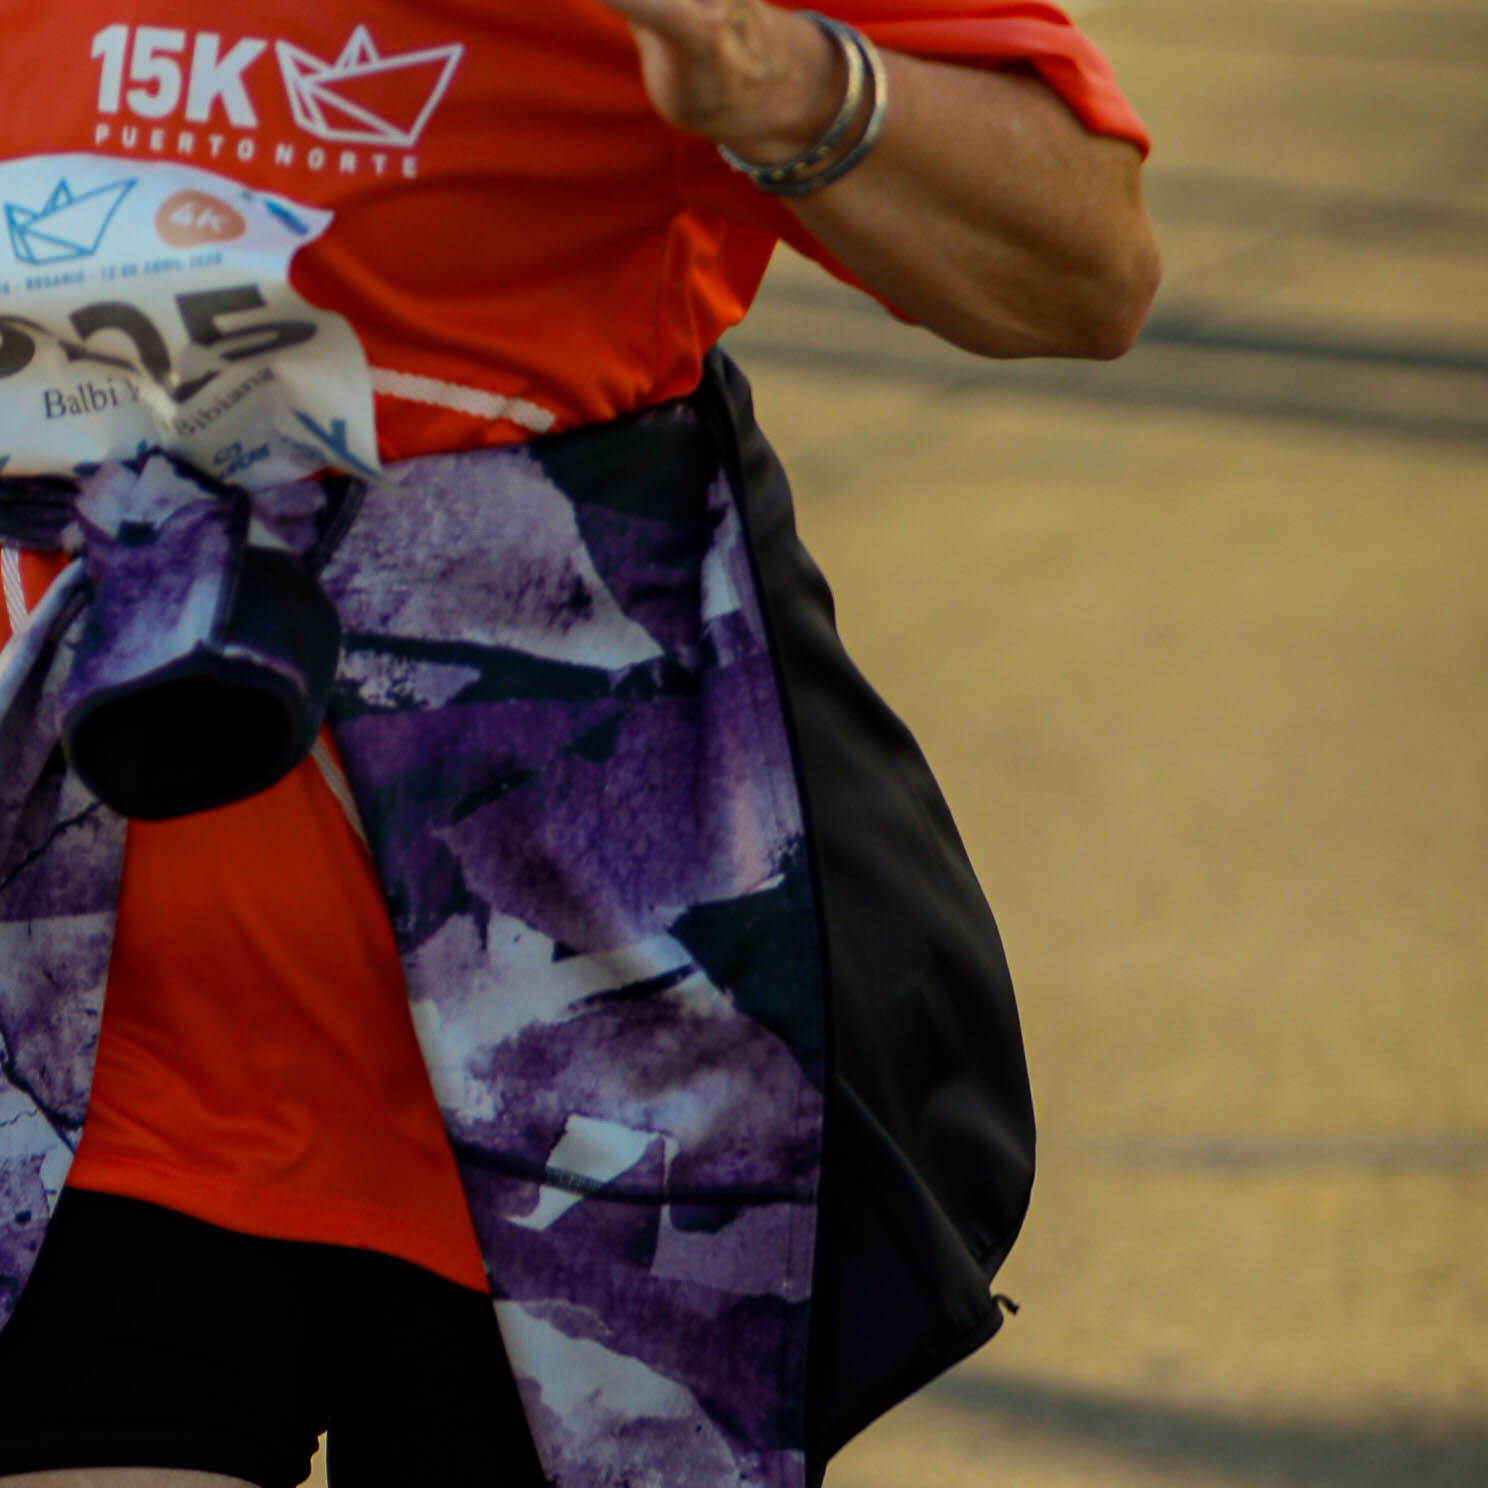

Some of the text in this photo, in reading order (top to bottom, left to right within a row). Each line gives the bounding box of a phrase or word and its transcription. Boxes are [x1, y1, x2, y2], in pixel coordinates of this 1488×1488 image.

[91, 24, 270, 129] 15K
[94, 123, 419, 178] PUERTO NORTE
[43, 376, 119, 419] Balbi
